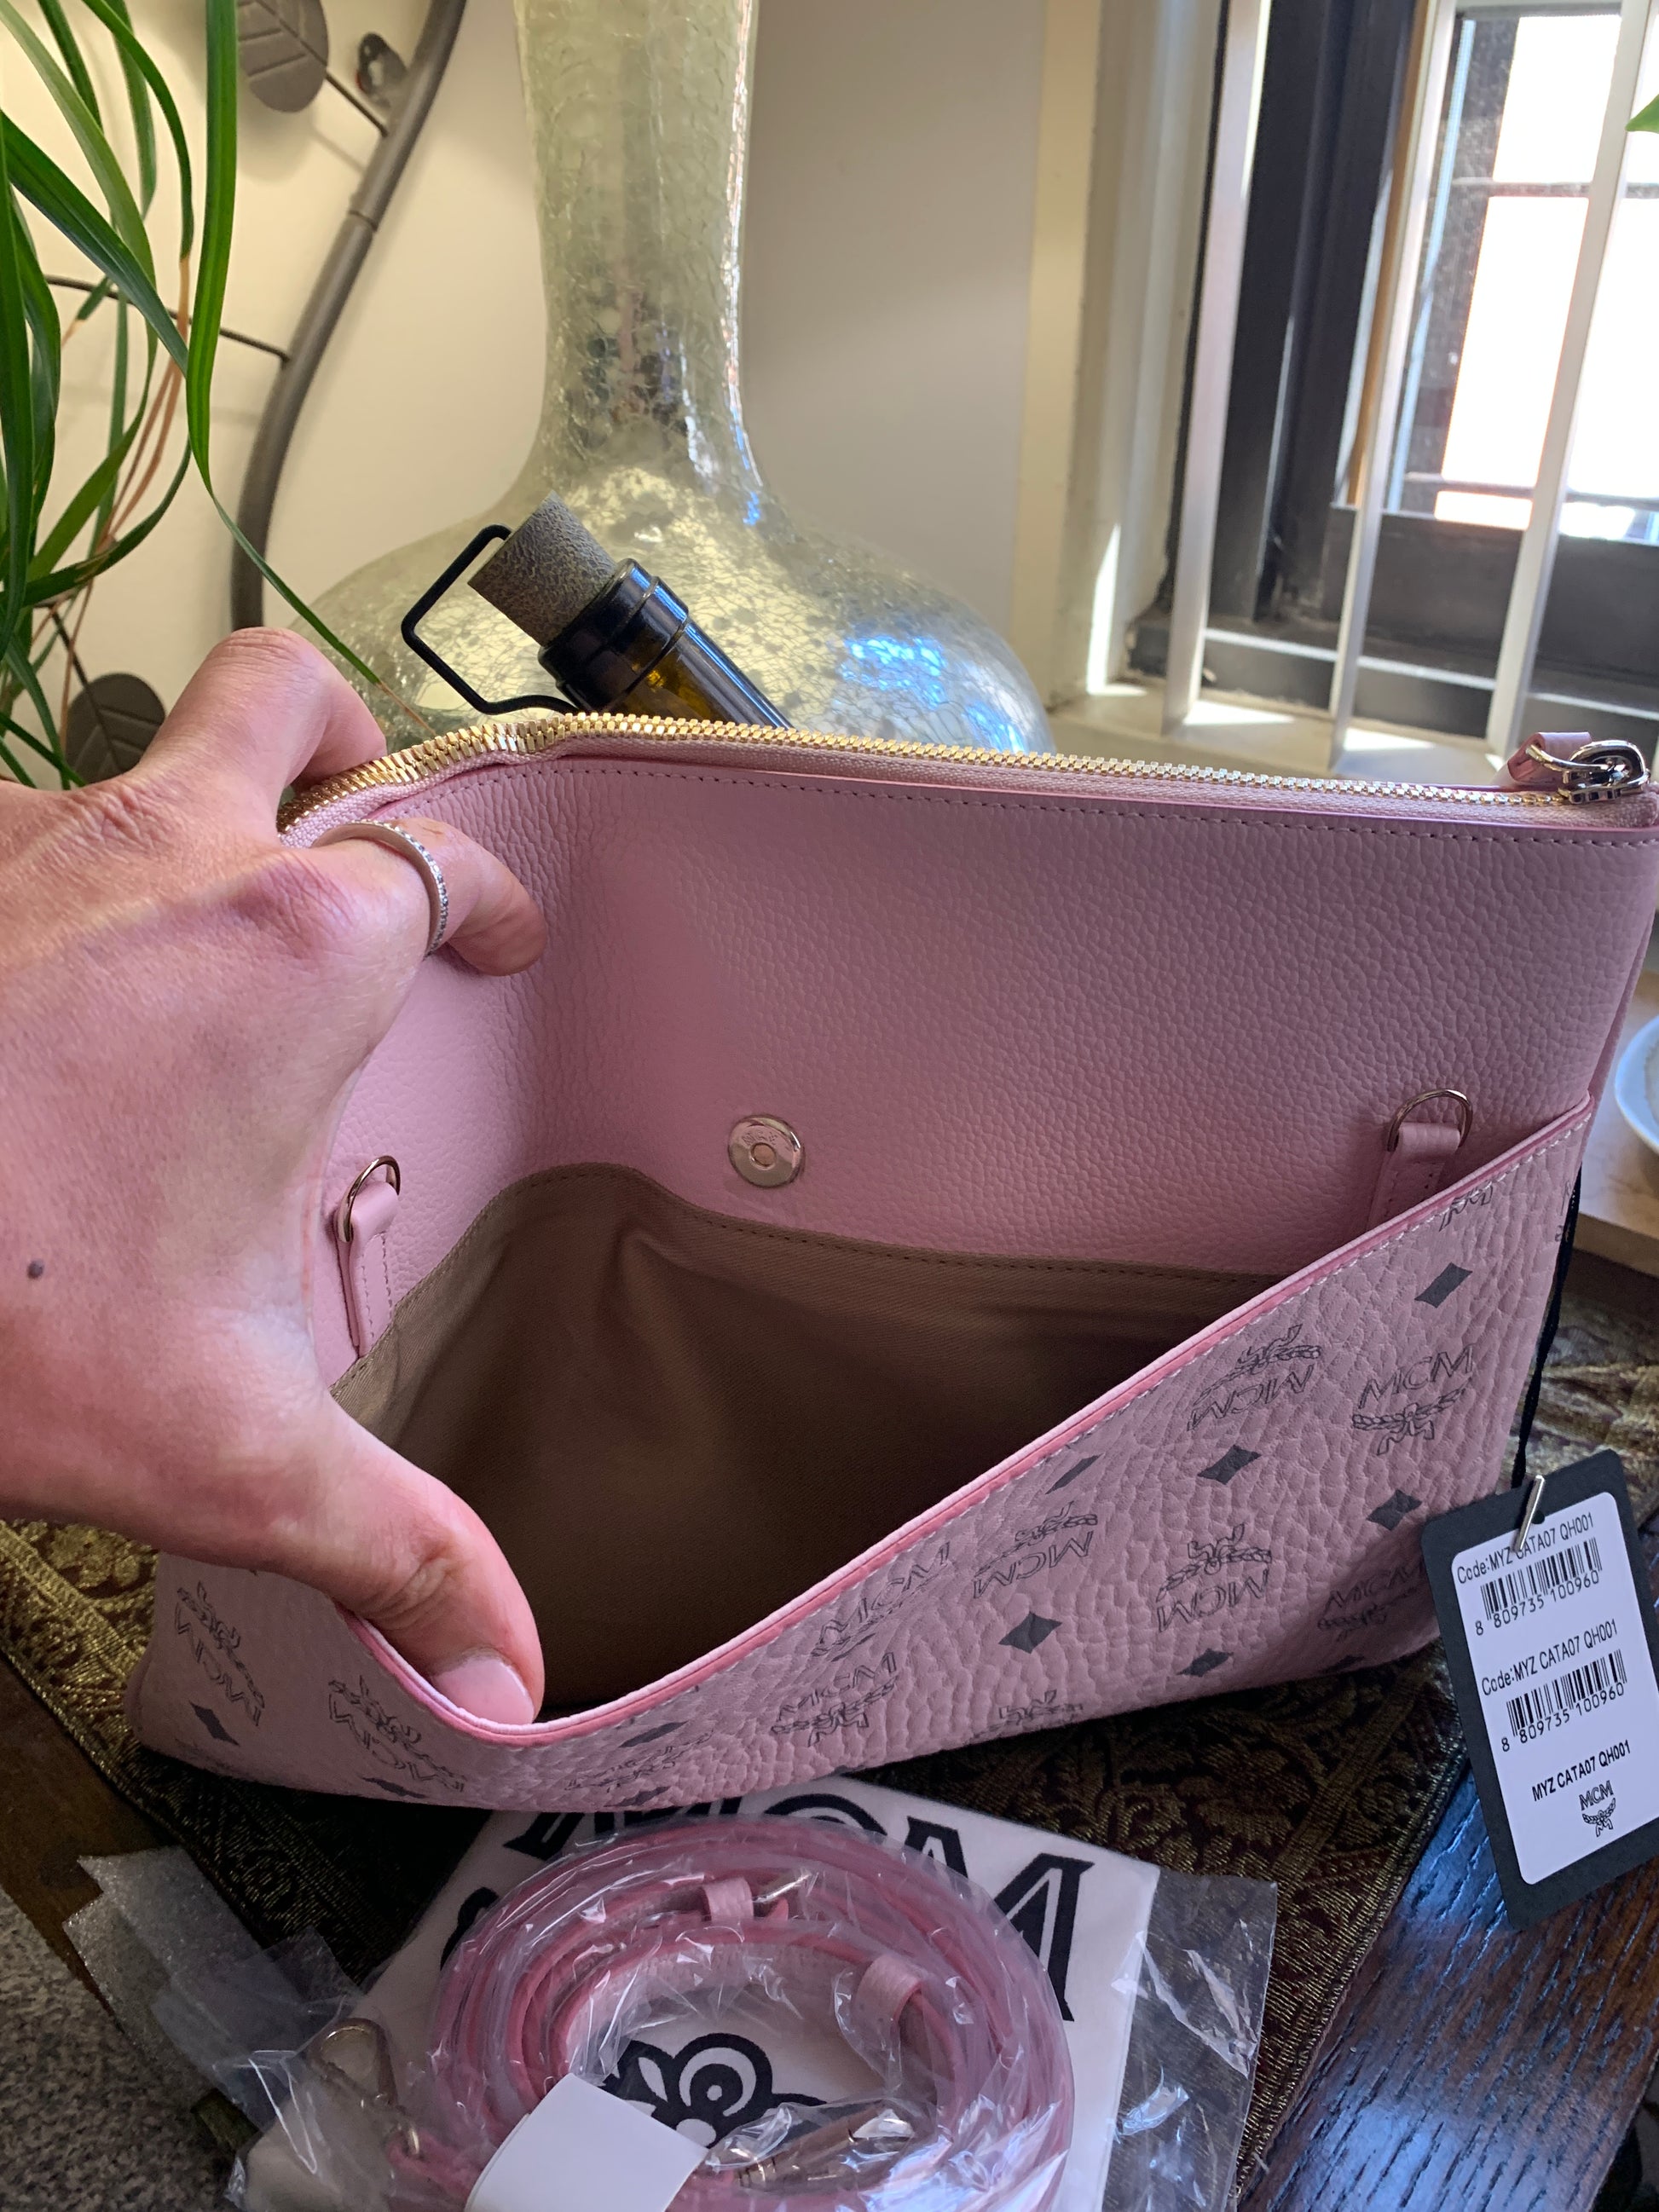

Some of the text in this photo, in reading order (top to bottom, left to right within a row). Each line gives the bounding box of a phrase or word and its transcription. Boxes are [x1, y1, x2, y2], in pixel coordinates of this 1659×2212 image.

[1187, 1364, 1314, 1432] MCM
[1358, 1343, 1476, 1410] MCM
[974, 1530, 1094, 1599] MCM
[1457, 1546, 1513, 1584] Code:MYZ
[1559, 1511, 1594, 1541] QH001
[1157, 1568, 1270, 1632] MCM
[1475, 1569, 1599, 1637] 8 809735 100960
[1482, 1619, 1618, 1695] Code:MYZ CATA07 QH001
[1501, 1682, 1625, 1752] 8 809735 100960
[1532, 1739, 1631, 1802] MYZ CATA07 QH001
[1578, 1780, 1614, 1811] MCM
